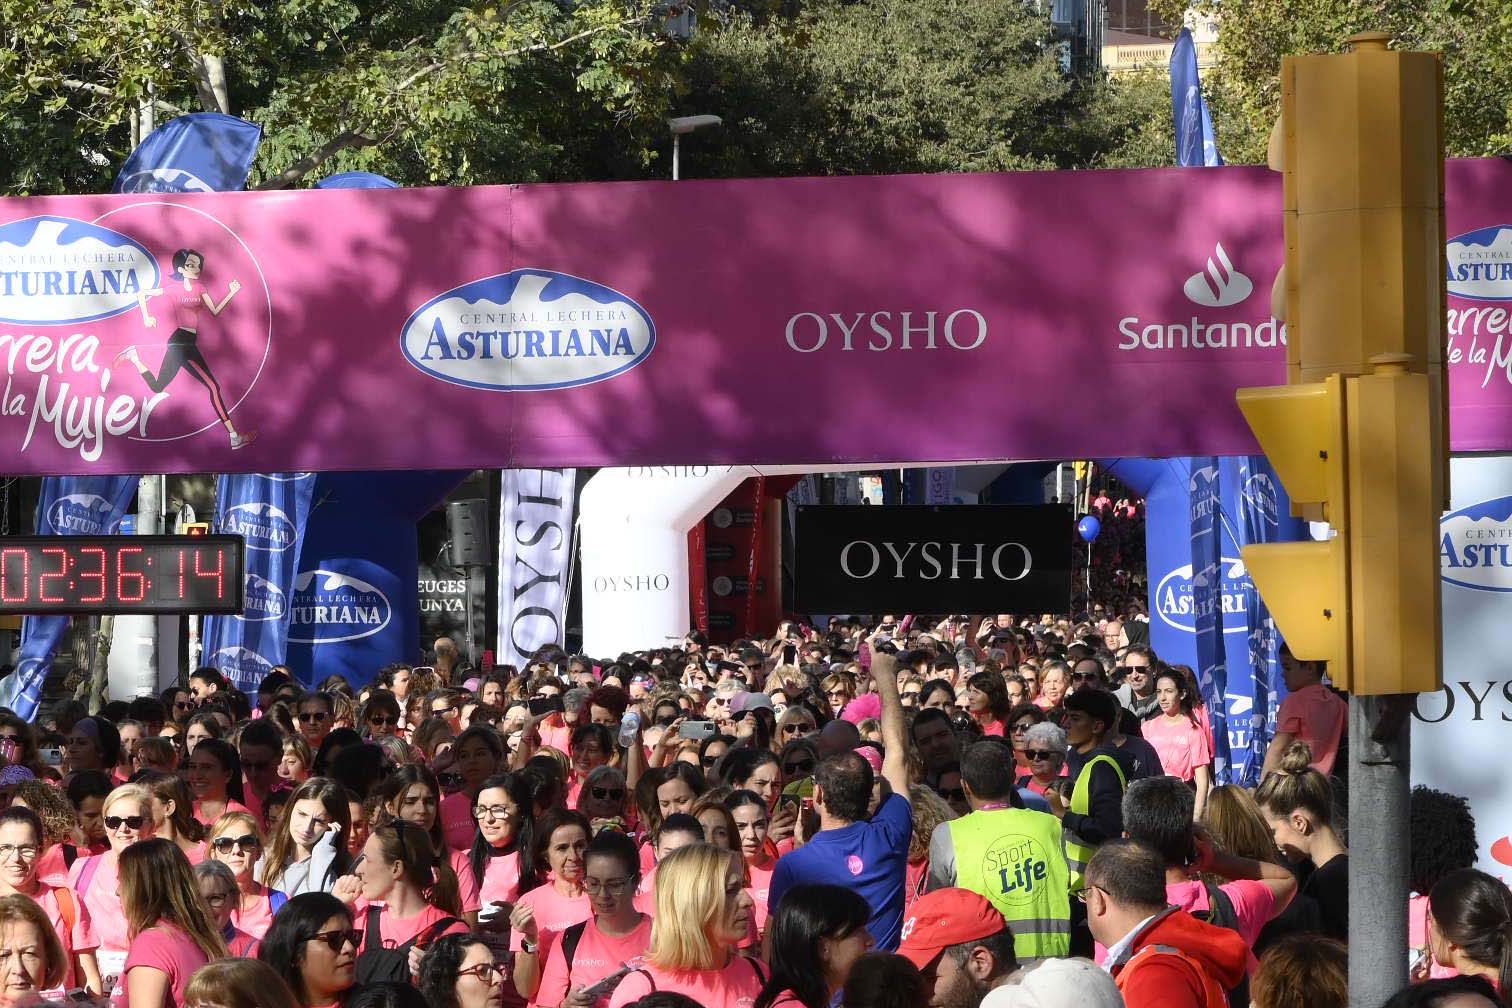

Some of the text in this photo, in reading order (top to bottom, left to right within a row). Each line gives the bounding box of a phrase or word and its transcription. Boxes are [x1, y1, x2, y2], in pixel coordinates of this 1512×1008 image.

[63, 252, 136, 264] LECHERA
[459, 310, 628, 325] CENTRAL LECHERA
[785, 309, 987, 353] OYSHO
[421, 317, 635, 360] ASTURIANA
[1469, 336, 1486, 364] la
[1, 376, 26, 417] la
[21, 369, 170, 462] Mujer
[1, 548, 223, 603] 02:36:14
[840, 540, 1033, 581] OYSHO
[594, 573, 670, 593] OYSHO
[986, 839, 1034, 871] Sport
[998, 857, 1047, 894] Life
